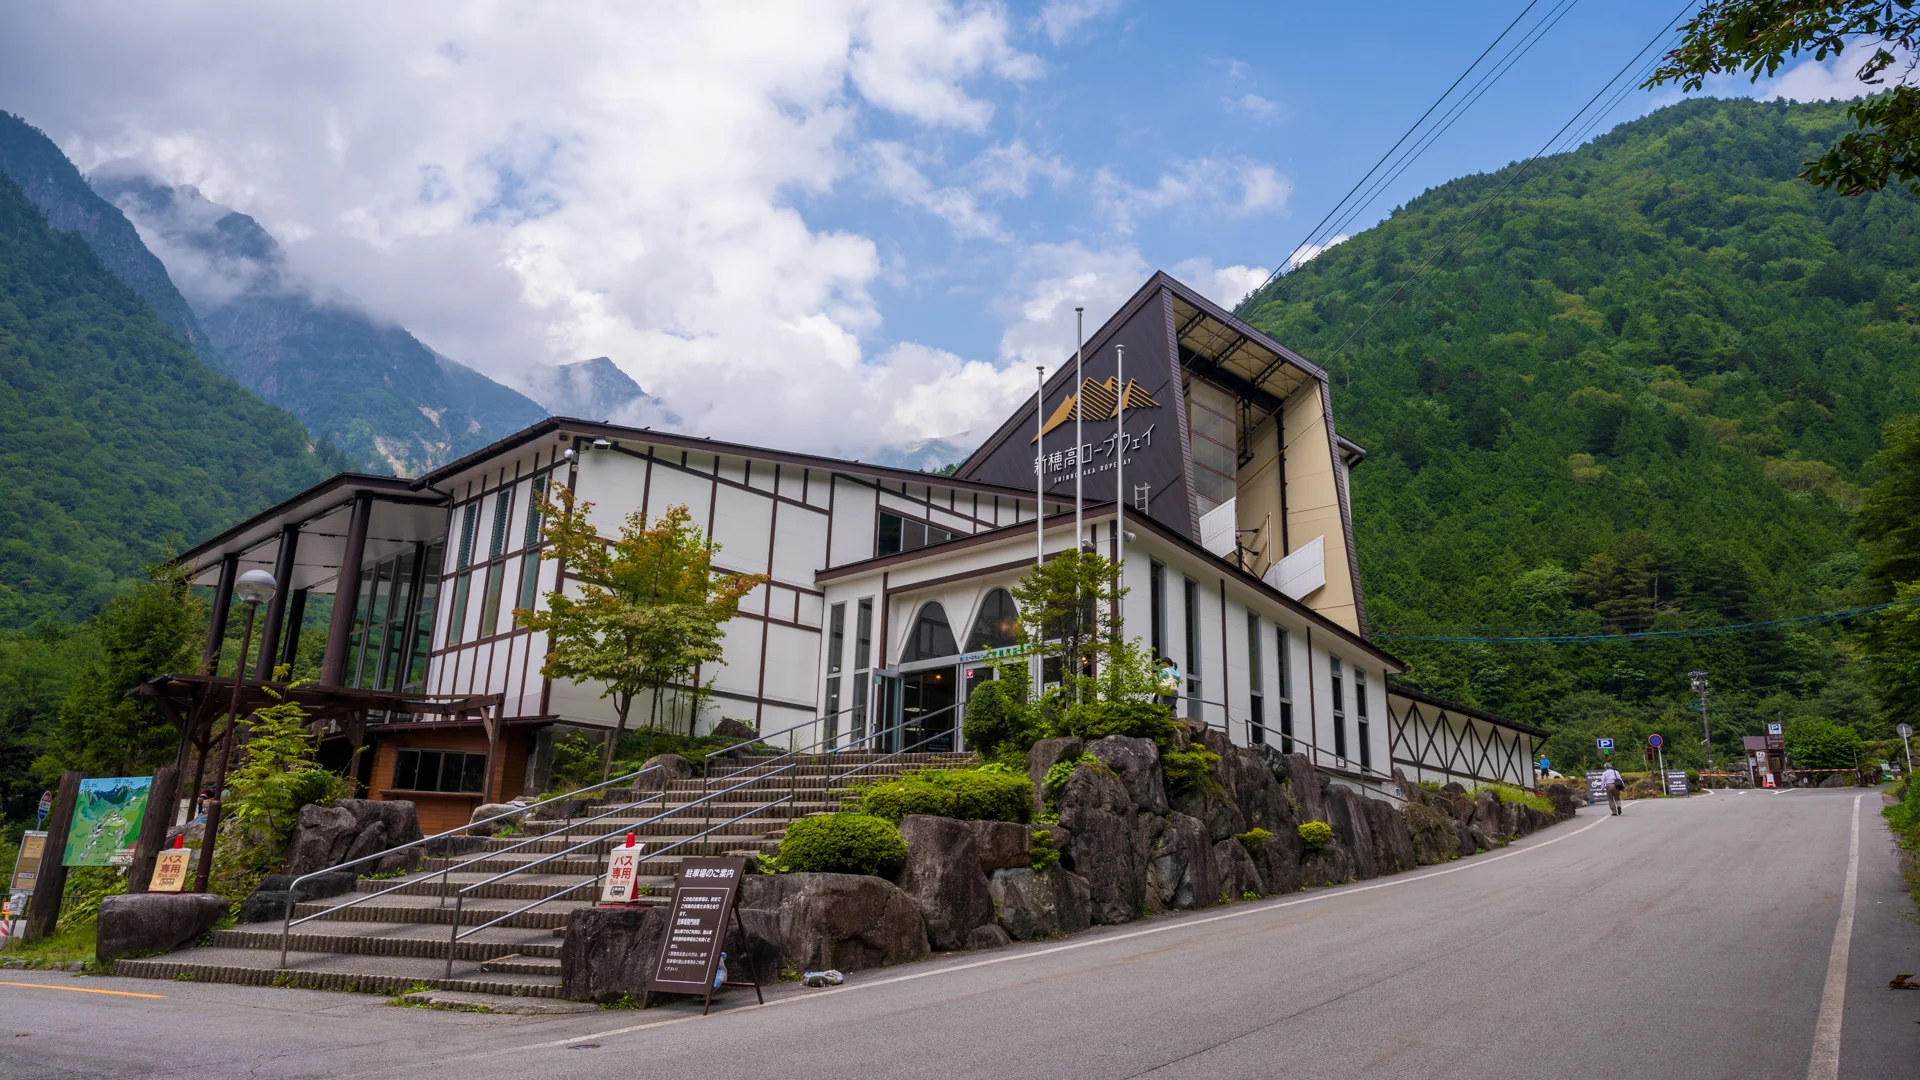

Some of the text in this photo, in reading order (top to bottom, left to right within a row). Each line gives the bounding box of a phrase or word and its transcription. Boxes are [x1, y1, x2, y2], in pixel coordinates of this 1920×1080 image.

[1033, 423, 1156, 477] 新穂高ロープウェイ
[1053, 458, 1132, 484] SHINHOAKA ROPEAY
[162, 855, 182, 864] バス
[614, 855, 633, 866] バス
[160, 864, 181, 874] 専用
[611, 867, 632, 879] 専用
[684, 868, 734, 878] 駐車場のご案内
